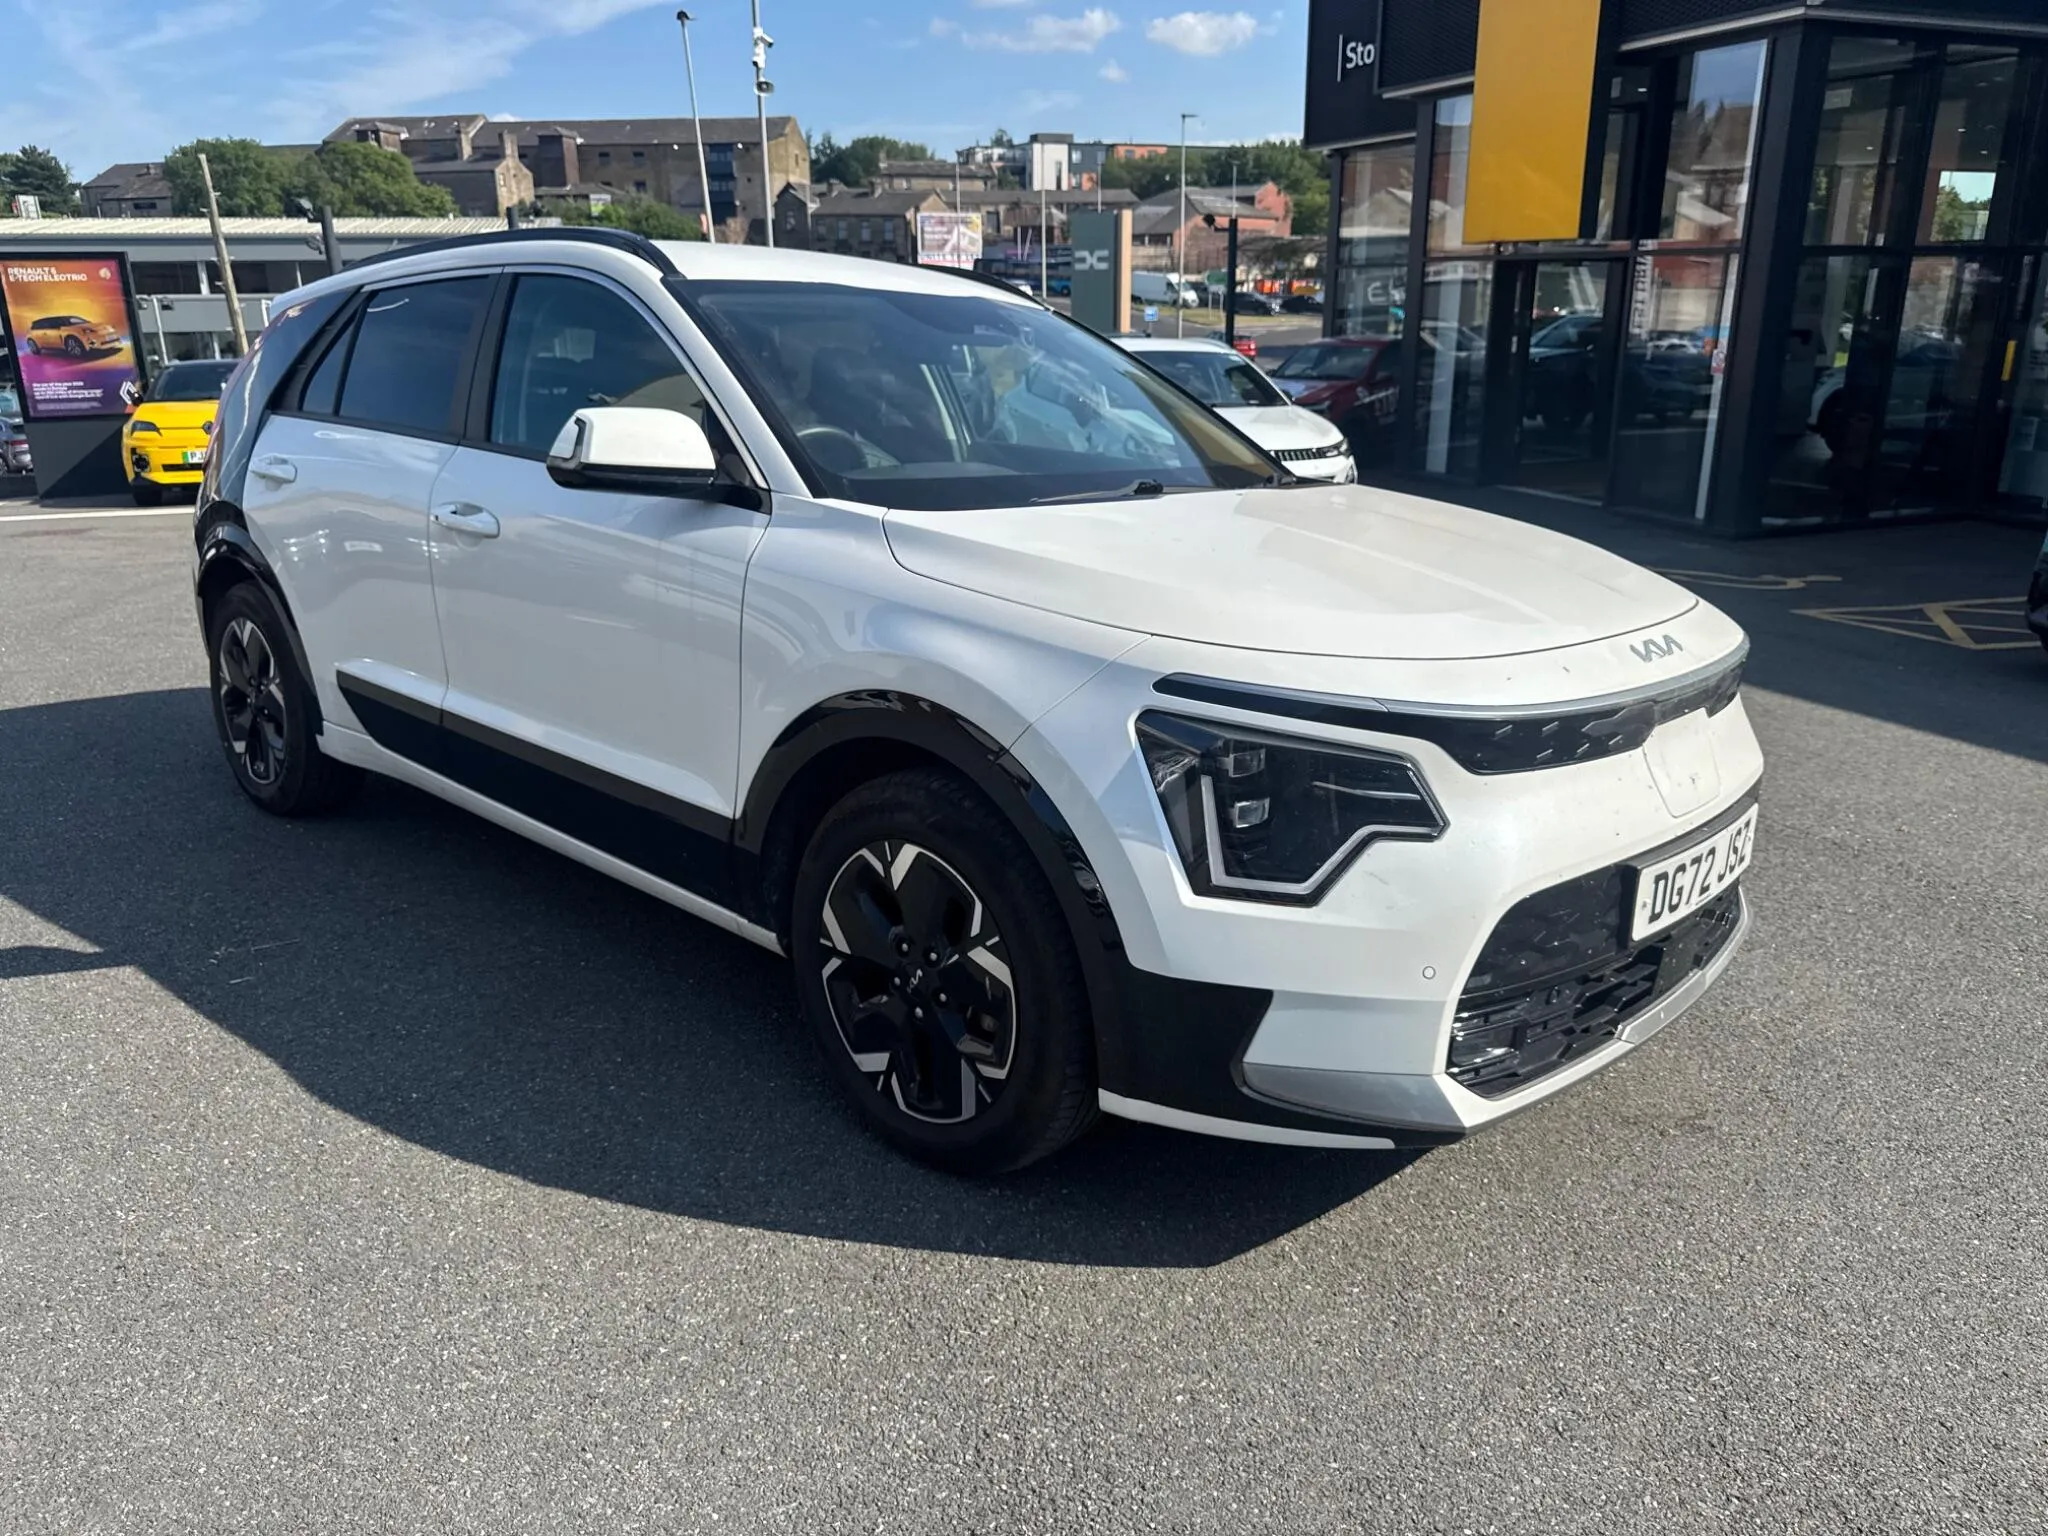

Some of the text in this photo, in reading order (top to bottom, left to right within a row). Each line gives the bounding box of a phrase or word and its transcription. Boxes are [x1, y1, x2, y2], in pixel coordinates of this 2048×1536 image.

[7, 267, 50, 276] RENAULT
[1648, 817, 1752, 924] DG72 JSZ
